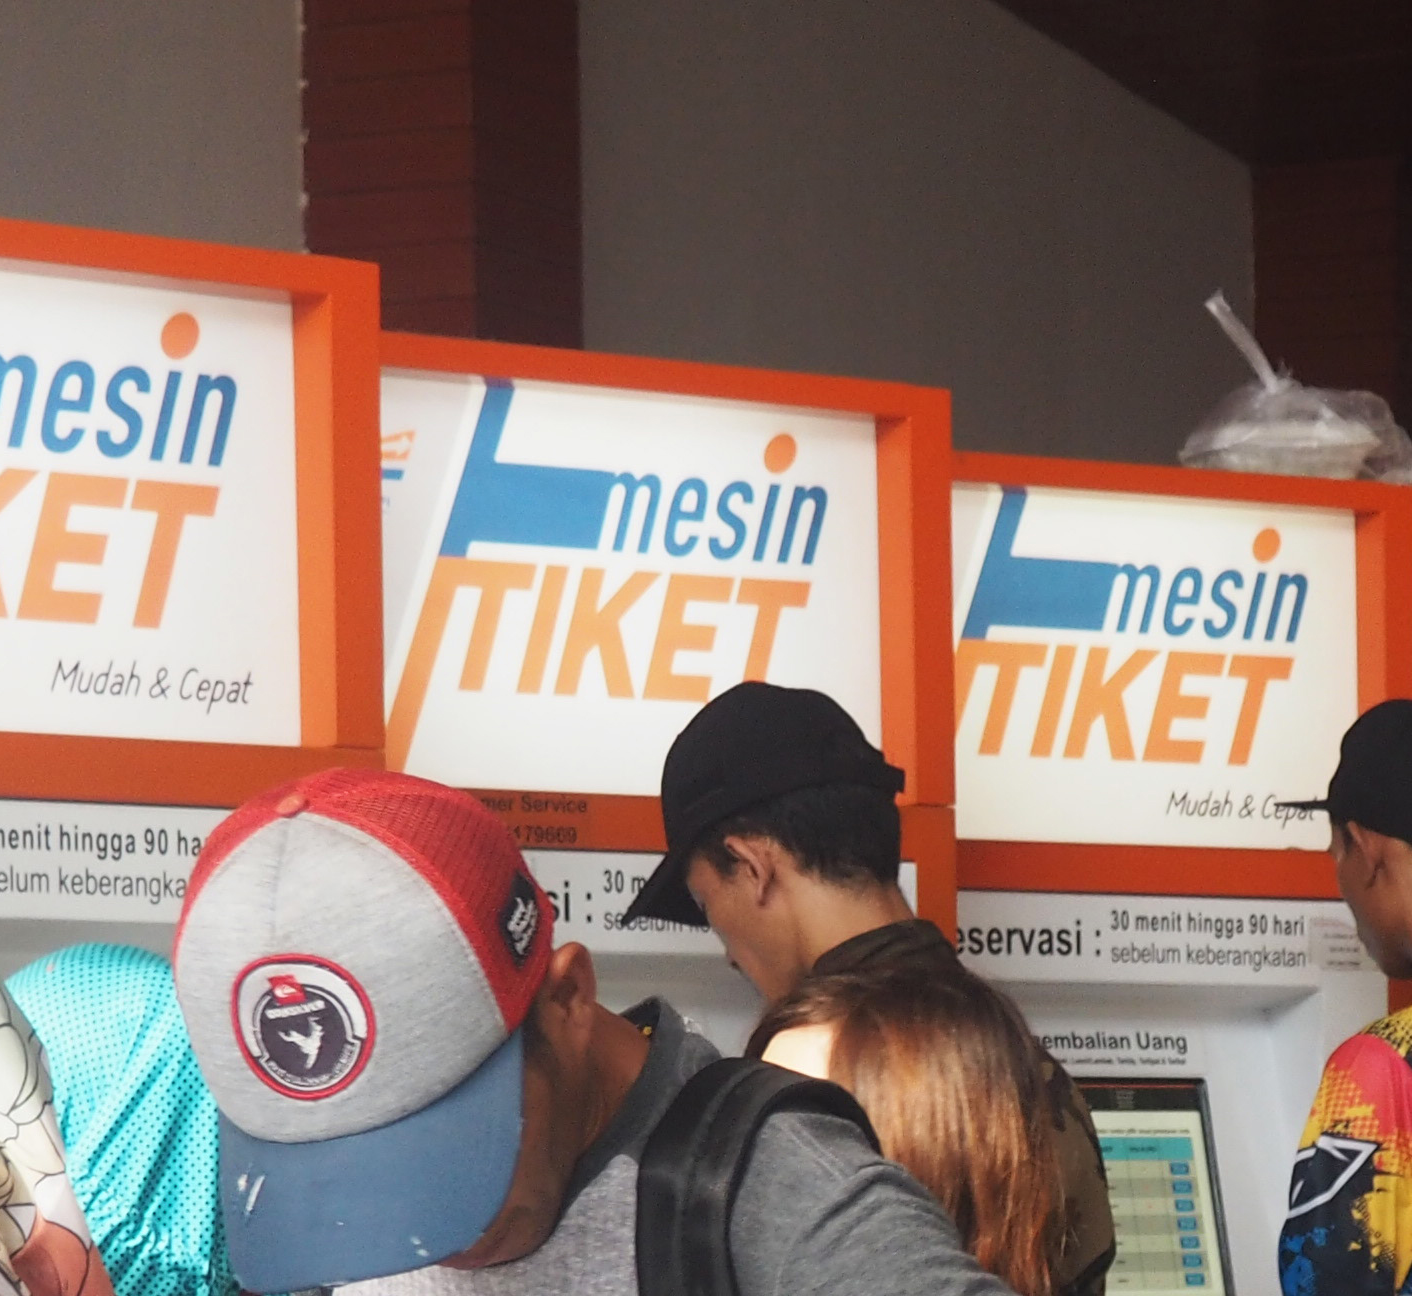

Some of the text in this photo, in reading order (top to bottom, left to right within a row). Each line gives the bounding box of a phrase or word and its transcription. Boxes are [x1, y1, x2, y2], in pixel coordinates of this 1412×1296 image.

[598, 433, 828, 565] mesin
[1102, 527, 1308, 643] mesin
[437, 556, 811, 703] TIKET
[51, 659, 254, 714] Mudah & Cepat
[958, 637, 1294, 766] TIKET
[521, 795, 587, 814] Service
[1166, 791, 1232, 820] Mudah
[1238, 796, 1253, 819] &
[60, 825, 136, 861] hingga
[144, 829, 168, 857] 90
[177, 830, 204, 857] ha
[58, 867, 186, 905] keberangka
[603, 869, 624, 895] 30
[957, 918, 1082, 957] eservasi
[1111, 910, 1305, 940] 30 menit hingga 90 hari
[1111, 942, 1181, 965] sebelum
[1186, 943, 1307, 973] keberangkatan
[1037, 1031, 1189, 1054] embalian Uang
